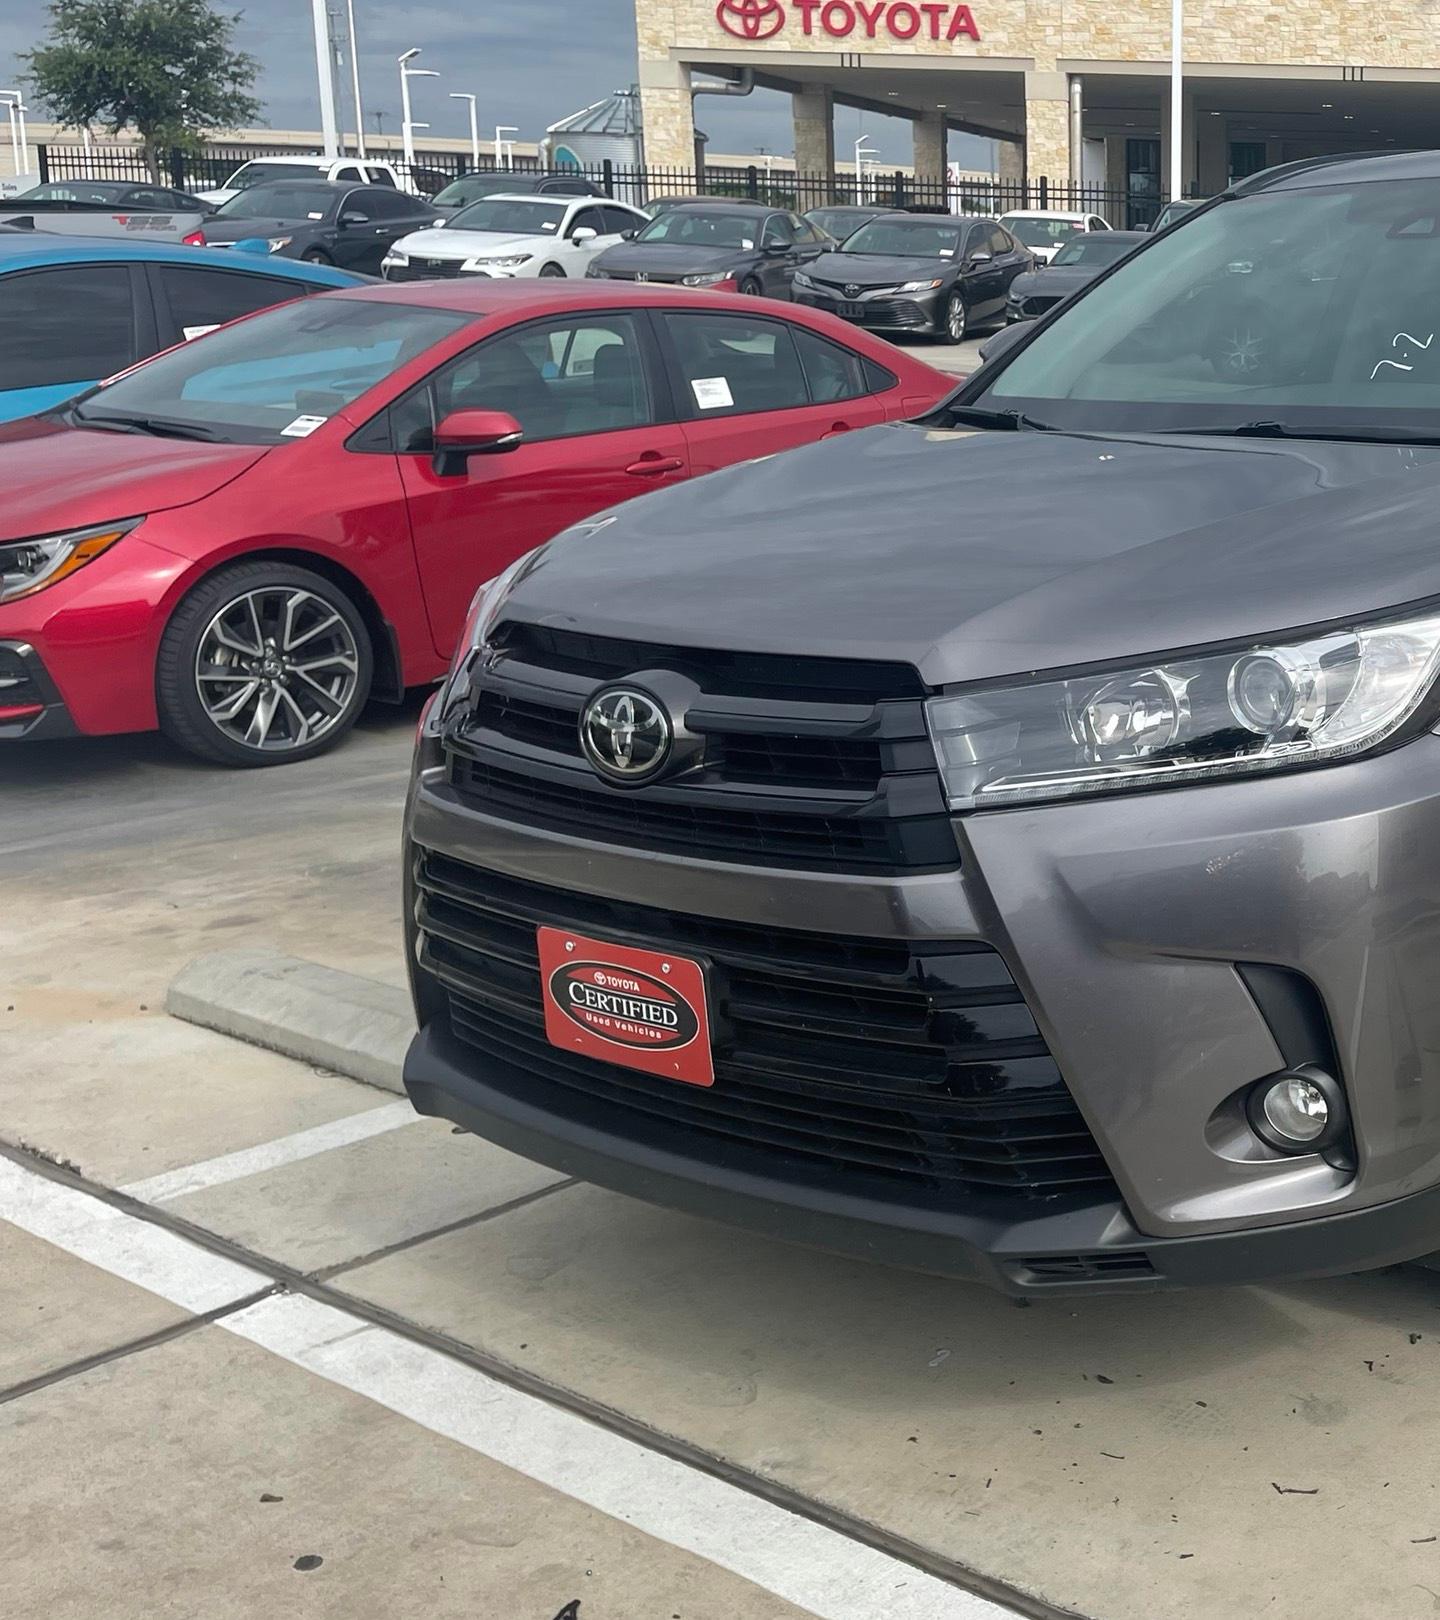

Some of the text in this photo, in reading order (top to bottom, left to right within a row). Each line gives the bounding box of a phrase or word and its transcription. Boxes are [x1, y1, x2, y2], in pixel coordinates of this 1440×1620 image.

[792, 0, 981, 41] TOYOTA
[606, 975, 640, 992] TOYOTA
[568, 981, 678, 1026] CERTIFIED
[585, 1012, 662, 1039] Used Vehicles
